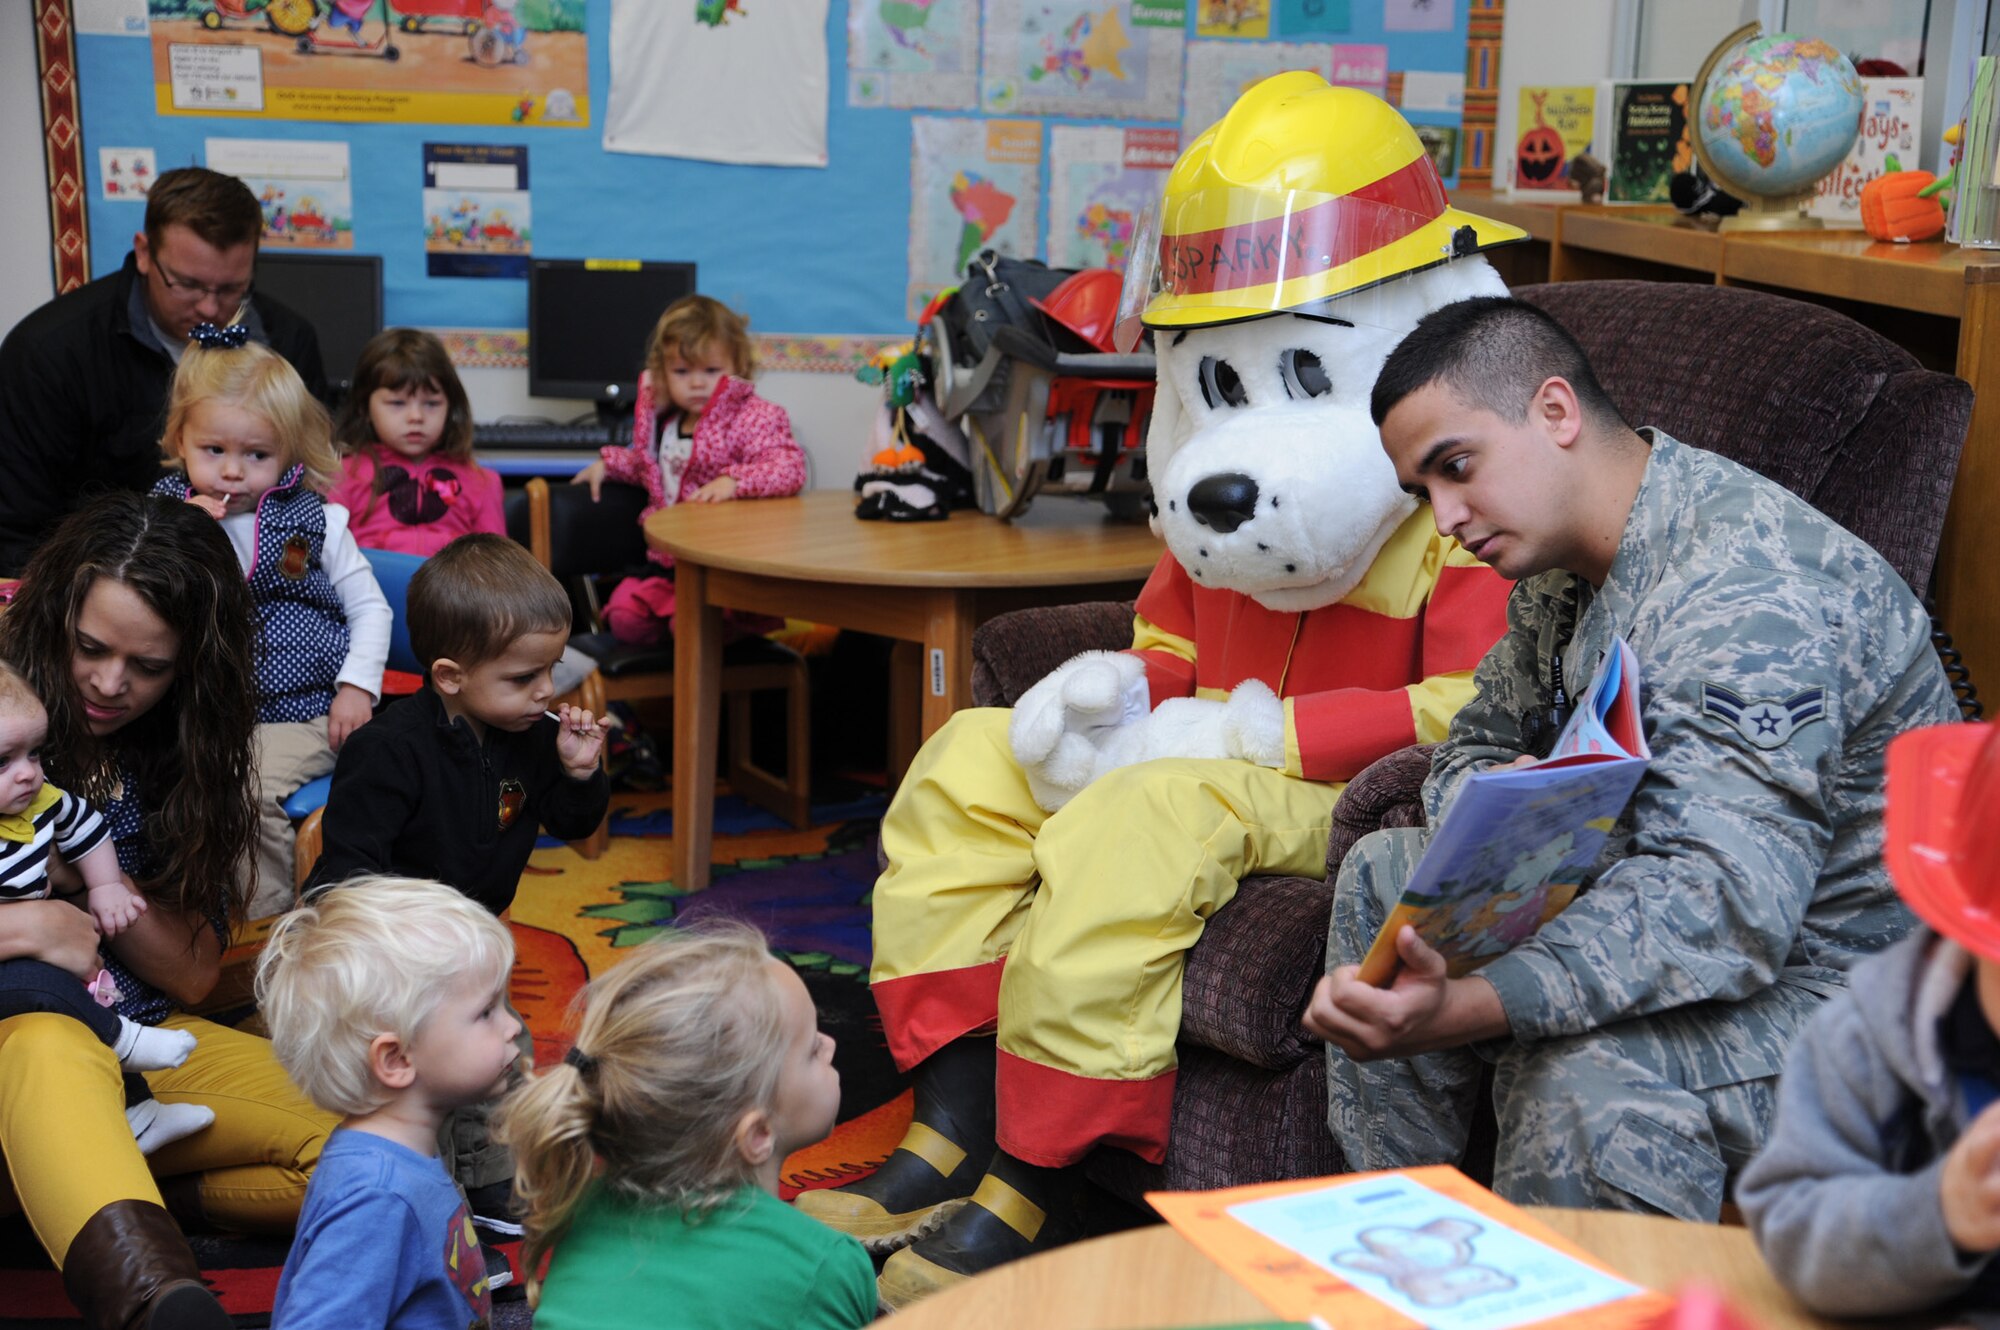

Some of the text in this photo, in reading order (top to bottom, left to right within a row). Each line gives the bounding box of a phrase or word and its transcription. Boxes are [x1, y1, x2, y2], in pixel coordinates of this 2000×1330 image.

[1132, 4, 1185, 22] Europe
[1336, 63, 1382, 81] Asia
[1124, 147, 1178, 163] Africa
[1173, 223, 1304, 280] SPARKY
